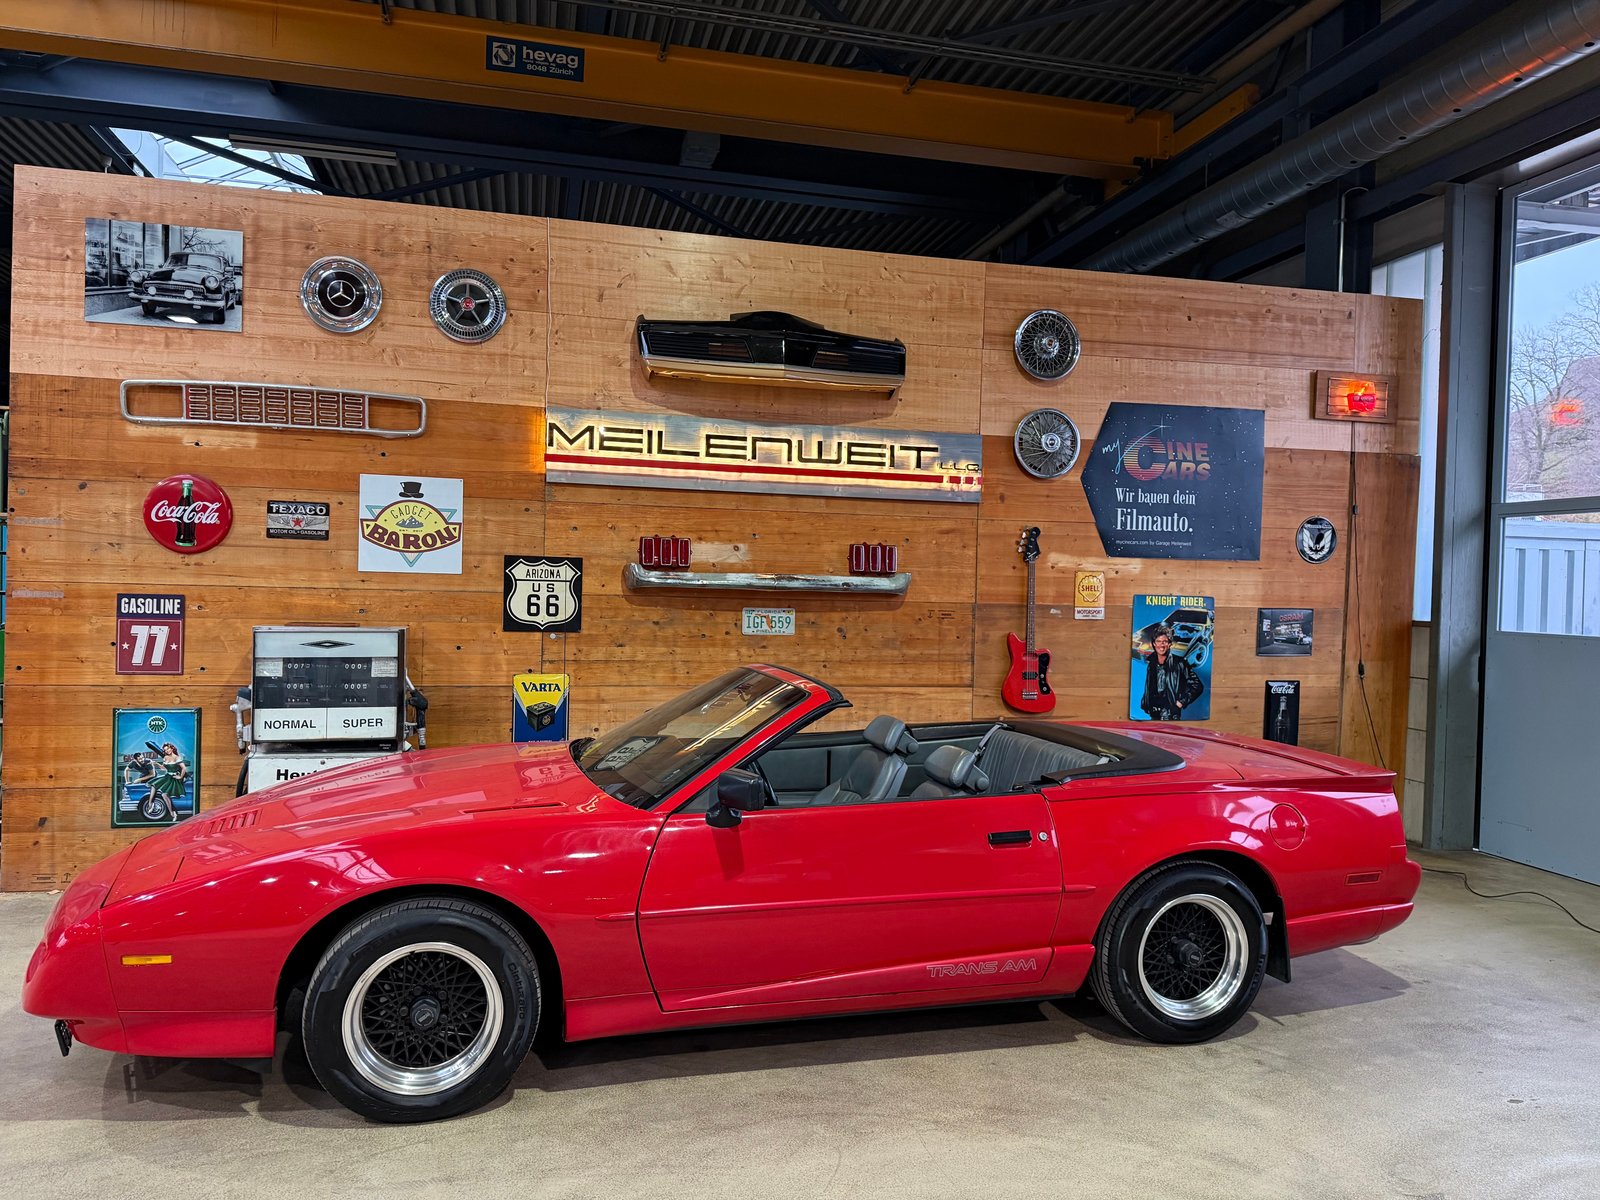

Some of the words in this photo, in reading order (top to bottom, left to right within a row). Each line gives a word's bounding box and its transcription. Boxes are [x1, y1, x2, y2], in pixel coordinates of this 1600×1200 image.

[523, 46, 578, 69] hevag
[549, 67, 574, 76] Zürich
[547, 422, 939, 470] MEILENWEIT
[1115, 488, 1135, 503] Wir
[1138, 488, 1169, 504] bauen
[1173, 490, 1196, 505] dein
[151, 500, 222, 525] Coca-Cola
[270, 504, 327, 515] TEXACO
[390, 505, 432, 520] GADGET
[1115, 508, 1193, 532] Filmauto.
[366, 523, 458, 549] BARON
[525, 568, 561, 579] ARIZONA
[121, 598, 181, 614] GASOLINE
[526, 594, 559, 617] 66
[1146, 596, 1177, 606] KNIGHT
[1279, 612, 1304, 622] OSRAM
[521, 682, 561, 692] VARTA
[264, 719, 316, 730] NORMAL
[342, 718, 383, 728] SUPER
[926, 961, 998, 978] TRANS
[1000, 958, 1037, 973] AM
